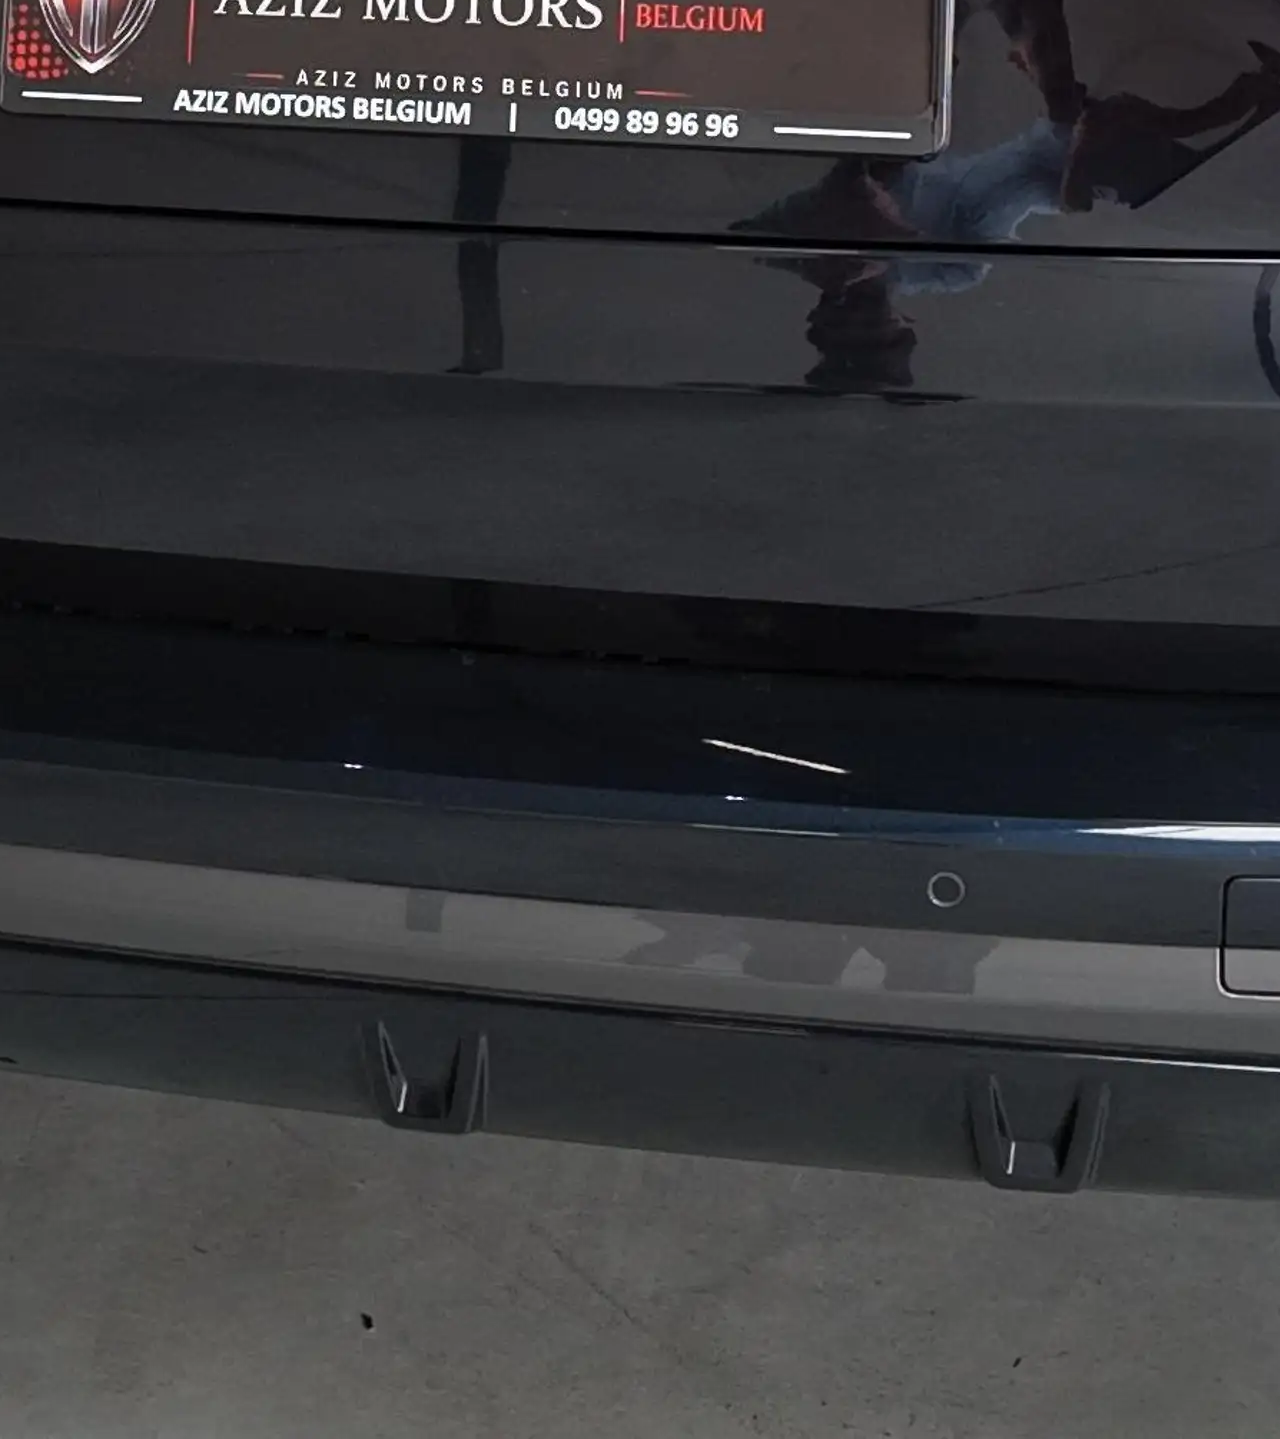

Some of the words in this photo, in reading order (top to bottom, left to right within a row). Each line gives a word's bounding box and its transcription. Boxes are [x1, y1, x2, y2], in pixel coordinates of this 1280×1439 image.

[636, 3, 765, 33] BELGIUM
[295, 69, 357, 89] AZIZ
[374, 72, 485, 95] MOTORS
[501, 77, 624, 101] BELGIUM
[172, 89, 229, 112] AZIZ
[234, 93, 347, 120] MOTORS
[352, 98, 472, 127] BELGIUM
[554, 106, 620, 133] 0499
[625, 110, 660, 136] 89
[665, 112, 700, 138] 96
[704, 113, 740, 139] 96
